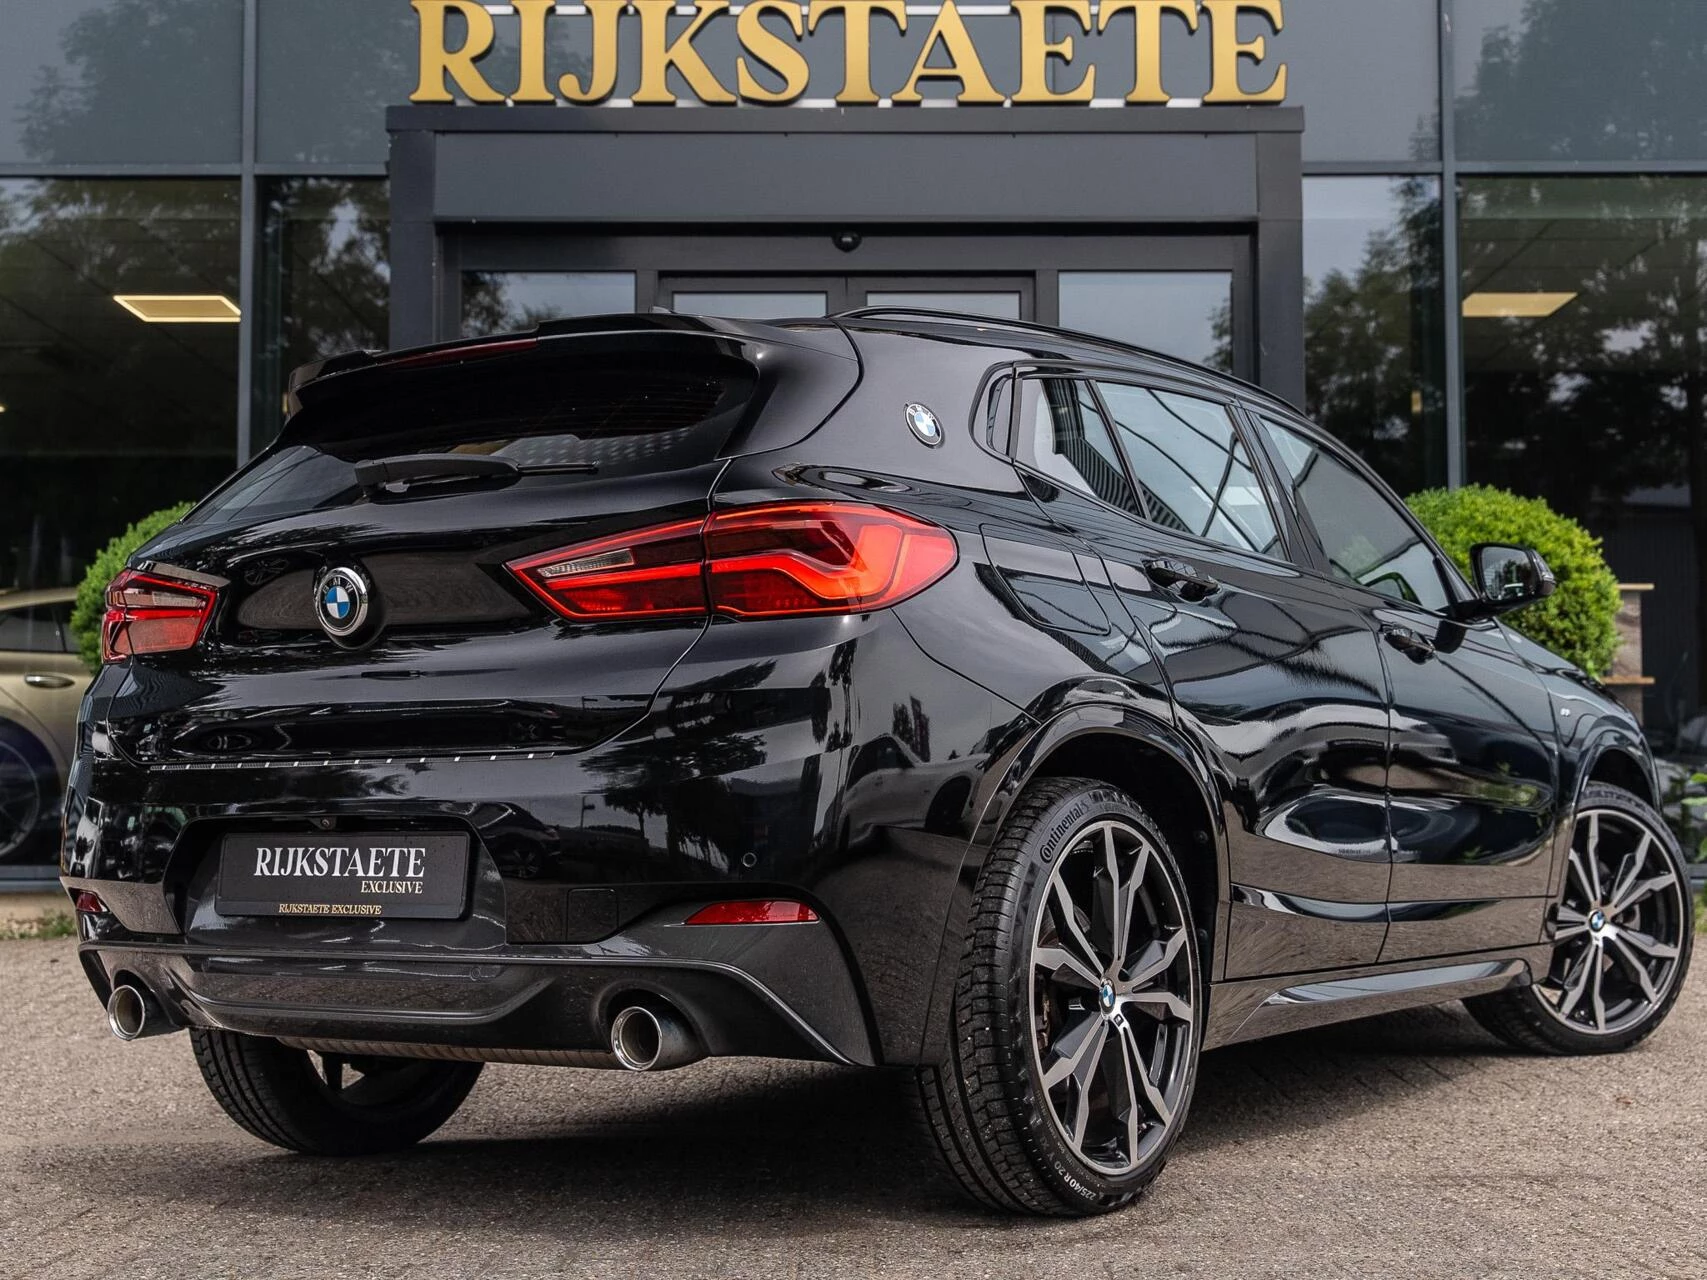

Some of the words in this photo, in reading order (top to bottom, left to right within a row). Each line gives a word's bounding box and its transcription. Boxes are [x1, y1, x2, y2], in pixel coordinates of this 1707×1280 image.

[409, 0, 1288, 104] RIJKSTAETE
[1040, 803, 1085, 863] Continental
[253, 847, 426, 878] RIJKSTAETE
[360, 880, 423, 894] EXCLUSIVE
[278, 903, 330, 914] RIJKSTAETE
[331, 904, 382, 915] EXCLUSIVE
